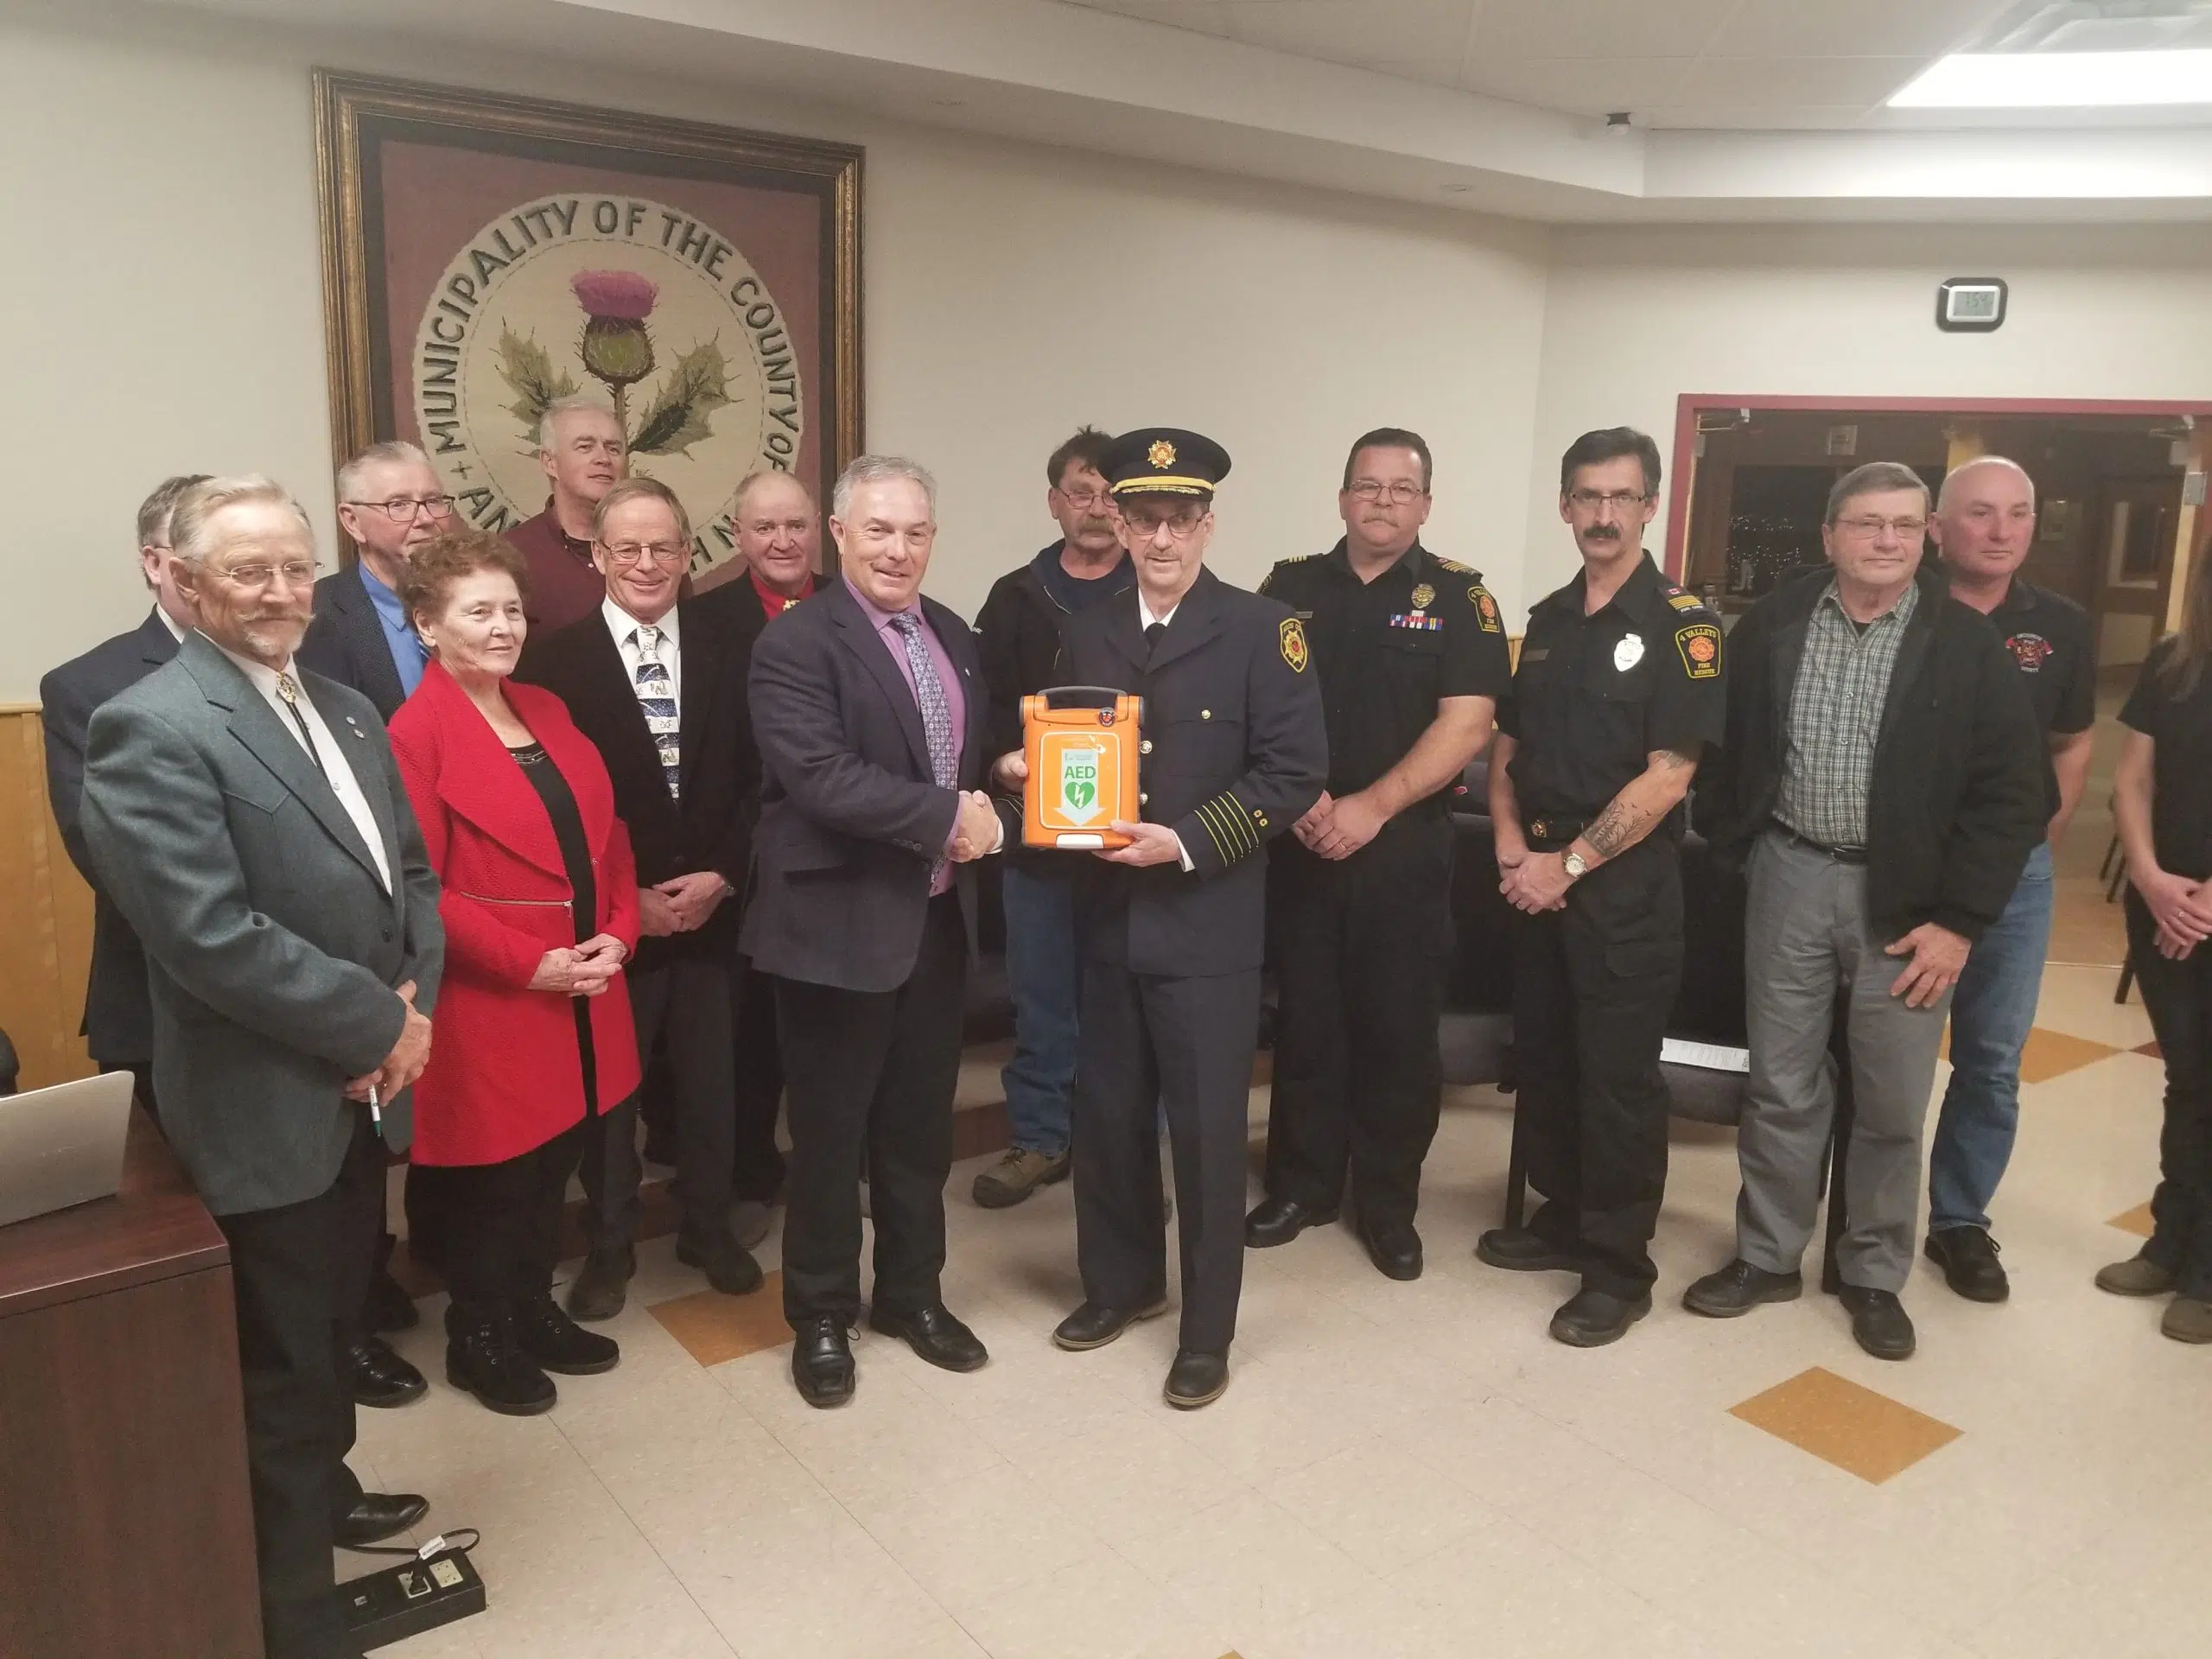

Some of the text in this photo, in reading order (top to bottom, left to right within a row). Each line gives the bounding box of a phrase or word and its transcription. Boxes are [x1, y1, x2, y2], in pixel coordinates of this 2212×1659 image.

[423, 200, 800, 472] MUNICIPALITY OF THE COUNTY OF
[1685, 628, 1717, 639] VALLEYS
[1064, 766, 1096, 779] AED
